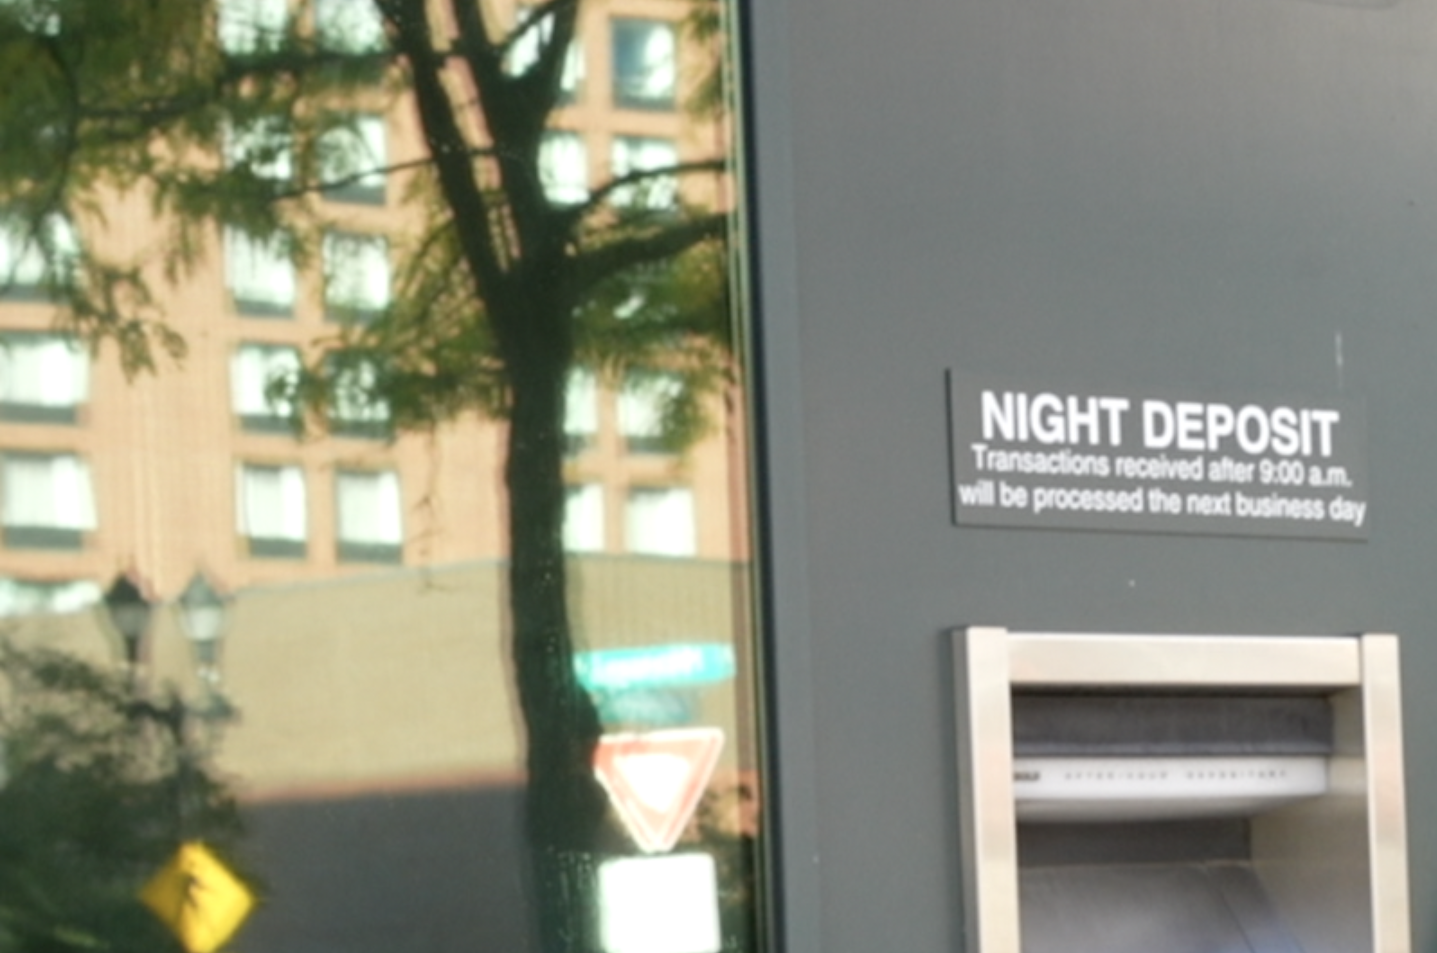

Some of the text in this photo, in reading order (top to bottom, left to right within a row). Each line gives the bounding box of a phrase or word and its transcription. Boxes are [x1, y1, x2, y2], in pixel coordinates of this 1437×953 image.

[981, 390, 1340, 457] NIGHT DEPOSIT
[971, 443, 1352, 489] Transactions received after 9:00 a.m.
[958, 480, 1366, 526] will be processed the next business day
